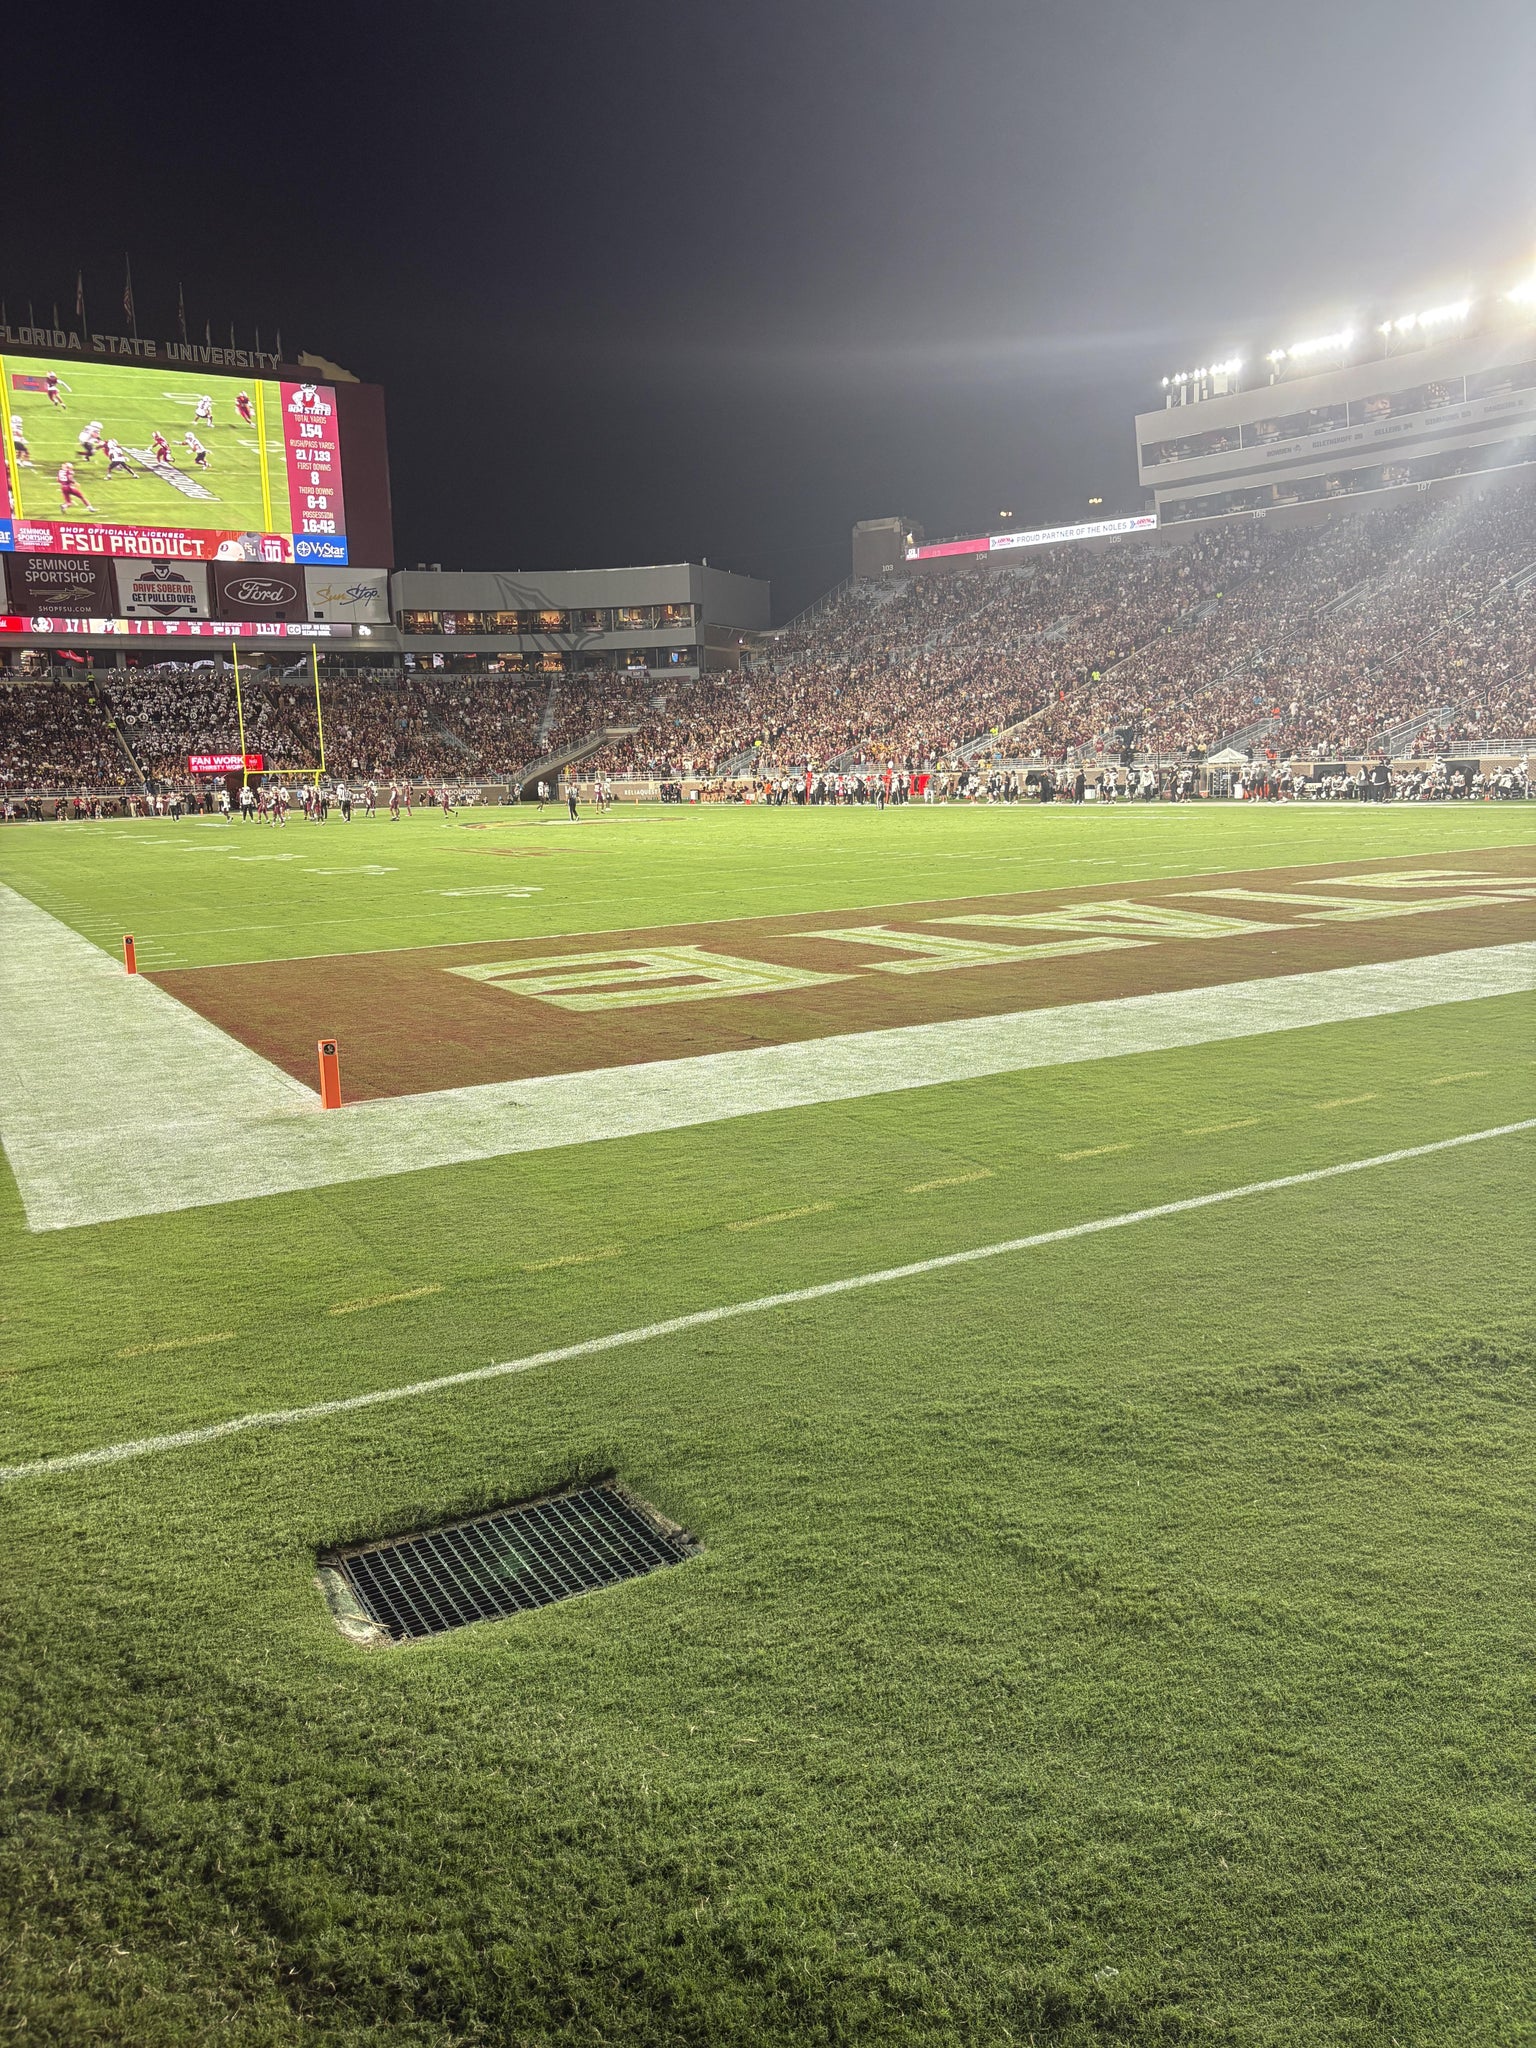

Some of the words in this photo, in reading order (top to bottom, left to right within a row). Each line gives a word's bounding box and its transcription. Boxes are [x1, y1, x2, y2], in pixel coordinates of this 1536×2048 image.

[91, 334, 156, 357] STATE
[165, 342, 280, 370] UNIVERSITY
[294, 414, 309, 423] TOTAL
[310, 416, 327, 424] YARDS
[300, 423, 322, 438] 154
[319, 441, 335, 450] YARDS
[296, 449, 307, 460] 21
[314, 450, 331, 461] 133
[297, 462, 312, 470] FIRST
[313, 463, 332, 472] DOWNS
[310, 471, 319, 485] 8
[299, 486, 315, 495] THIRD
[315, 487, 334, 496] DOWNS
[1416, 481, 1432, 491] 107
[307, 495, 327, 509] 6-9
[302, 511, 334, 519] POSSESSION
[1252, 511, 1266, 519] 106
[302, 519, 335, 534] 16:42
[1016, 534, 1040, 543] PROUD
[1042, 529, 1074, 540] PARTNER
[1076, 528, 1085, 536] OF
[1087, 525, 1101, 535] THE
[1102, 522, 1127, 532] NOLES
[17, 534, 53, 542] SPORTSHOP
[88, 528, 138, 536] OFFICIALLY
[142, 531, 184, 539] LICENSED
[61, 533, 104, 552] FSU
[109, 535, 205, 556] PRODUCT
[309, 541, 345, 557] VyStar
[264, 546, 281, 562] 00
[28, 559, 90, 571] SEMINOLE
[882, 564, 894, 572] 103
[25, 571, 96, 583] SPORTSHOP
[132, 583, 156, 593] DRIVE
[156, 584, 182, 593] SOBER
[183, 585, 194, 594] OR
[238, 581, 284, 601] Ford
[132, 593, 146, 602] GET
[148, 594, 176, 603] PULLED
[176, 594, 196, 603] OVER
[65, 618, 79, 632] 17
[135, 620, 142, 634] 7
[288, 625, 300, 634] CC
[191, 757, 211, 765] FAN
[213, 756, 245, 765] WORK
